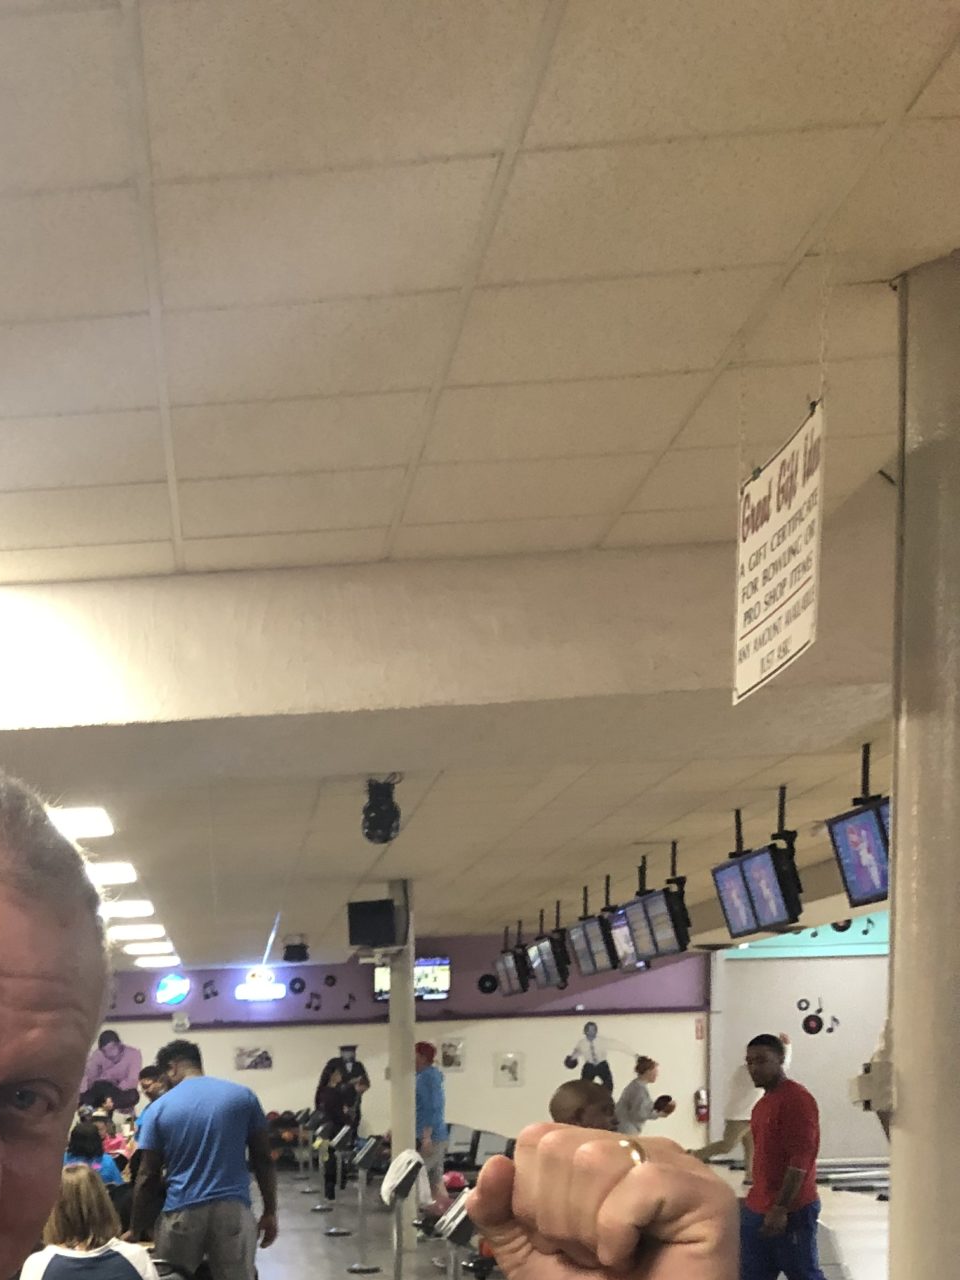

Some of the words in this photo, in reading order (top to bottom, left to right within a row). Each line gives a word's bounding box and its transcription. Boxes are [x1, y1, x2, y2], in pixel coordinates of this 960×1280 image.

[777, 450, 799, 513] Gift
[740, 563, 745, 577] A
[748, 542, 768, 572] GIFT
[771, 487, 818, 552] CERTIFICATE
[742, 577, 759, 604] FOR
[762, 534, 802, 587] BOWLING
[804, 518, 815, 545] OR
[743, 601, 761, 628] PRO
[764, 577, 788, 611] SHOP
[790, 550, 813, 589] ITEMS
[738, 643, 750, 663] ANY
[753, 616, 782, 652] AMOUNT
